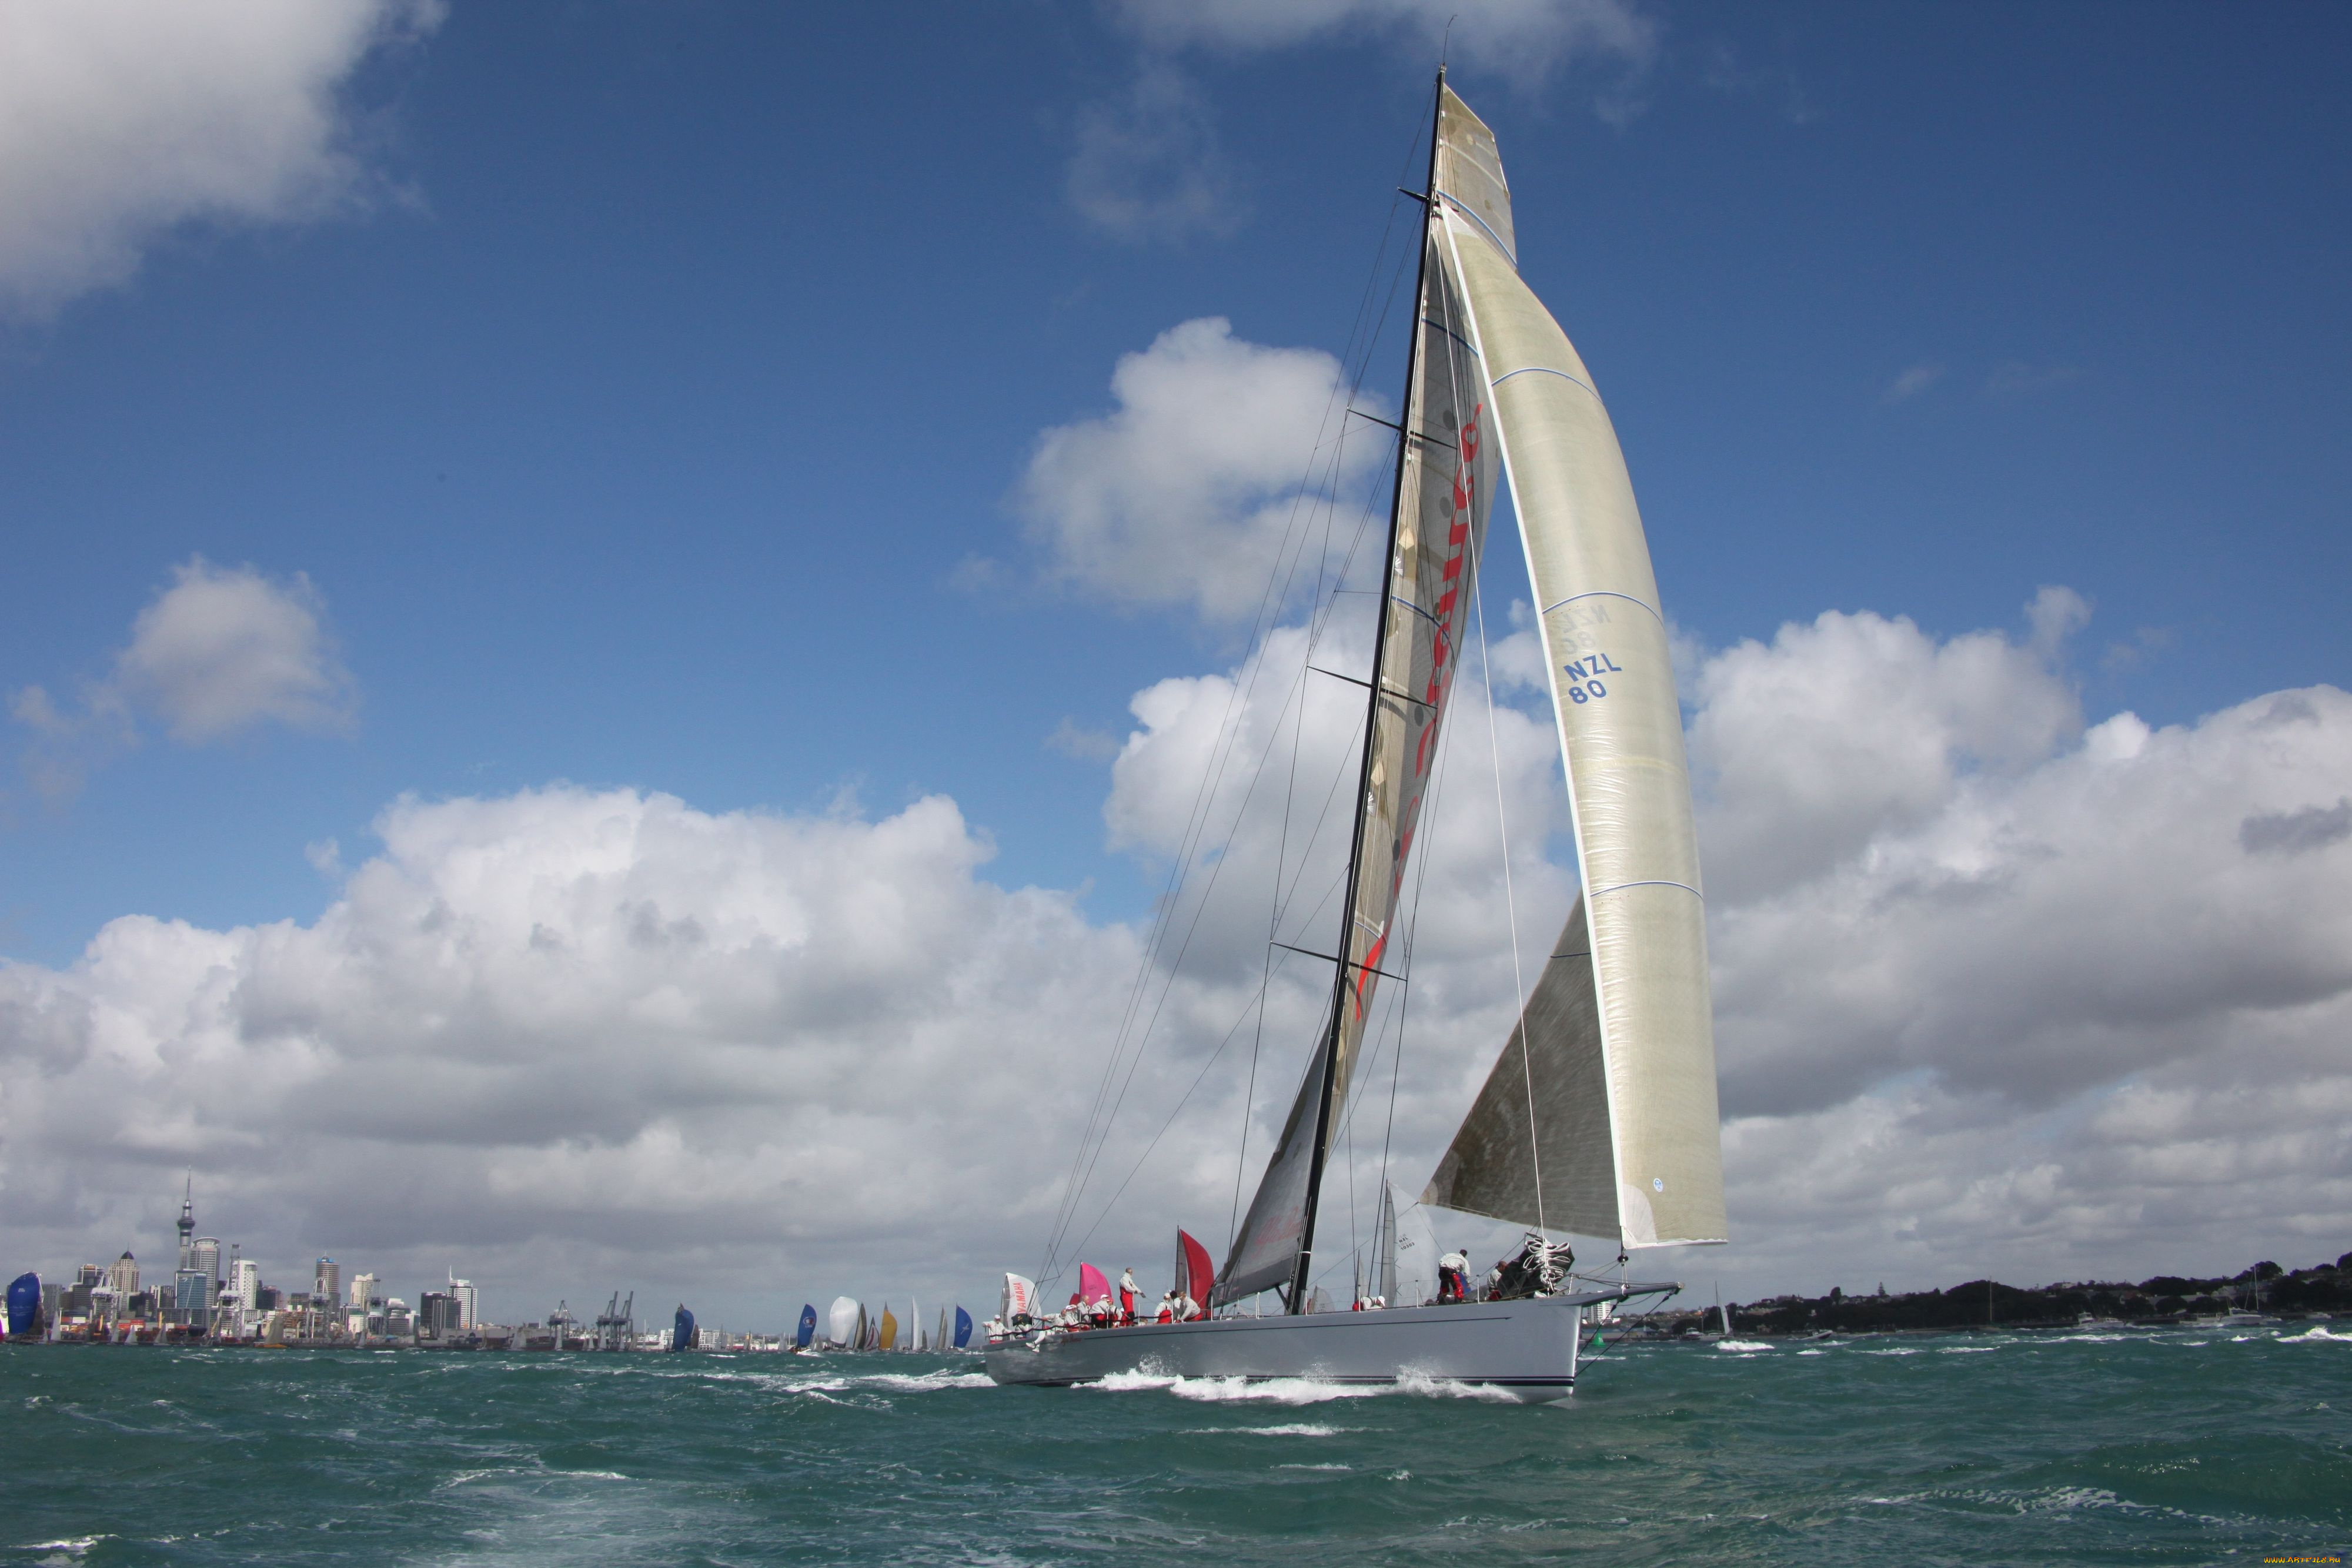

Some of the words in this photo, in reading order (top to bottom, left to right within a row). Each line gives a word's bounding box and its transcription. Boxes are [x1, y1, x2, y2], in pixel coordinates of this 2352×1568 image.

[1563, 653, 1622, 682] NZL
[1568, 680, 1607, 704] 80
[1013, 1282, 1026, 1313] YAMAHA
